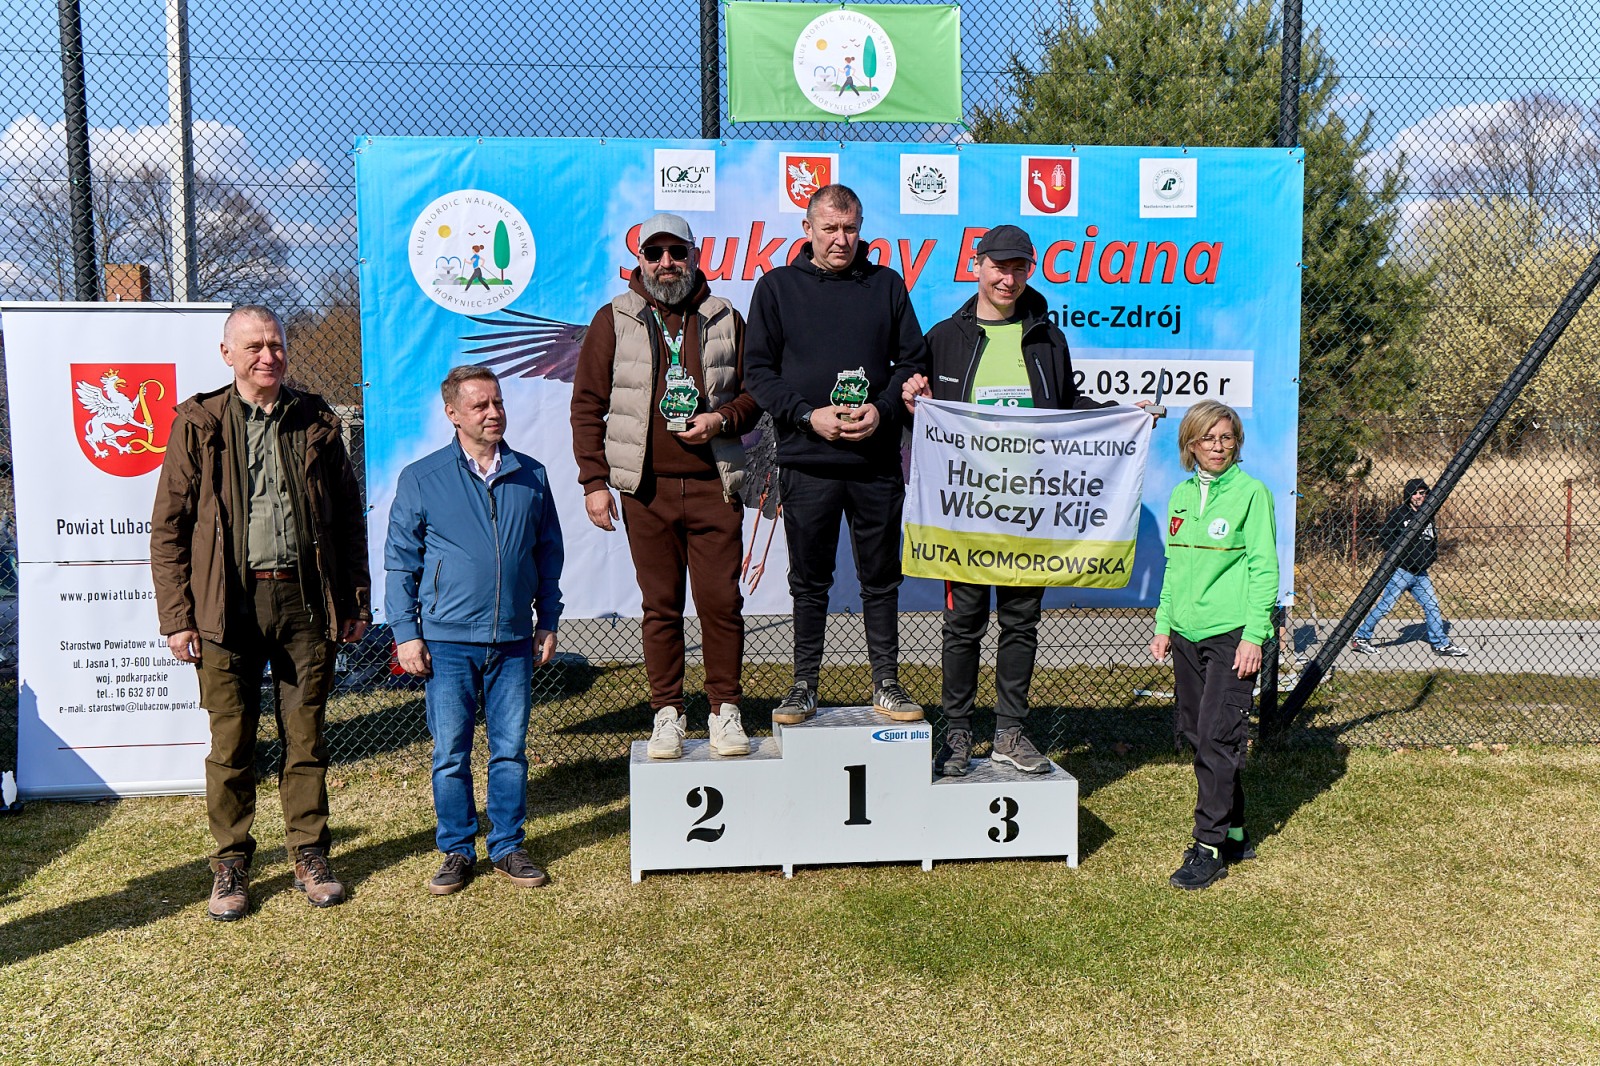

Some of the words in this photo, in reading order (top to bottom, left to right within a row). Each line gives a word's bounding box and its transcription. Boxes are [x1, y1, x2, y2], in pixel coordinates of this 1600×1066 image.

[798, 43, 807, 65] KLUB
[805, 16, 834, 40] NORDIC
[839, 15, 877, 34] WALKING
[878, 35, 892, 67] SPRING
[417, 230, 427, 255] KLUB
[425, 199, 459, 226] NORDIC
[465, 197, 511, 218] WALKING
[512, 220, 528, 256] SPRING
[954, 225, 1224, 285] Bciana
[435, 286, 514, 308] HORYNIEC-ZDRÓJ
[1047, 304, 1181, 335] niec-Zdrój
[1073, 370, 1209, 395] 2.03.2026
[1219, 377, 1231, 395] r
[926, 424, 965, 449] KLUB
[971, 435, 1046, 454] NORDIC
[1051, 440, 1137, 457] WALKING
[948, 460, 1104, 497] Hucieńskie
[57, 518, 104, 535] Powiat
[110, 518, 153, 535] Lubac
[940, 489, 1045, 532] Włóczy
[1054, 501, 1108, 534] Kije
[911, 541, 962, 566] HUTA
[968, 548, 1126, 575] KOMOROWSKA
[60, 640, 101, 651] Starostwo
[104, 639, 147, 650] Powiatowe
[73, 660, 83, 669] ul.
[86, 659, 109, 669] Jasna
[111, 658, 118, 669] 1,
[121, 657, 150, 668] 37-600
[96, 673, 113, 685] woj.
[116, 672, 168, 684] podkarpackie
[59, 704, 86, 713] e-mail:
[88, 701, 200, 713] starostwo@lubaczow.powiat.
[96, 689, 114, 698] tel.:
[116, 688, 125, 698] 16
[128, 687, 144, 697] 632
[146, 687, 155, 697] 87
[157, 686, 168, 697] 00
[884, 731, 907, 740] sport
[911, 730, 930, 740] plus
[843, 765, 872, 826] 1
[686, 786, 725, 843] 2
[987, 796, 1020, 843] 3
